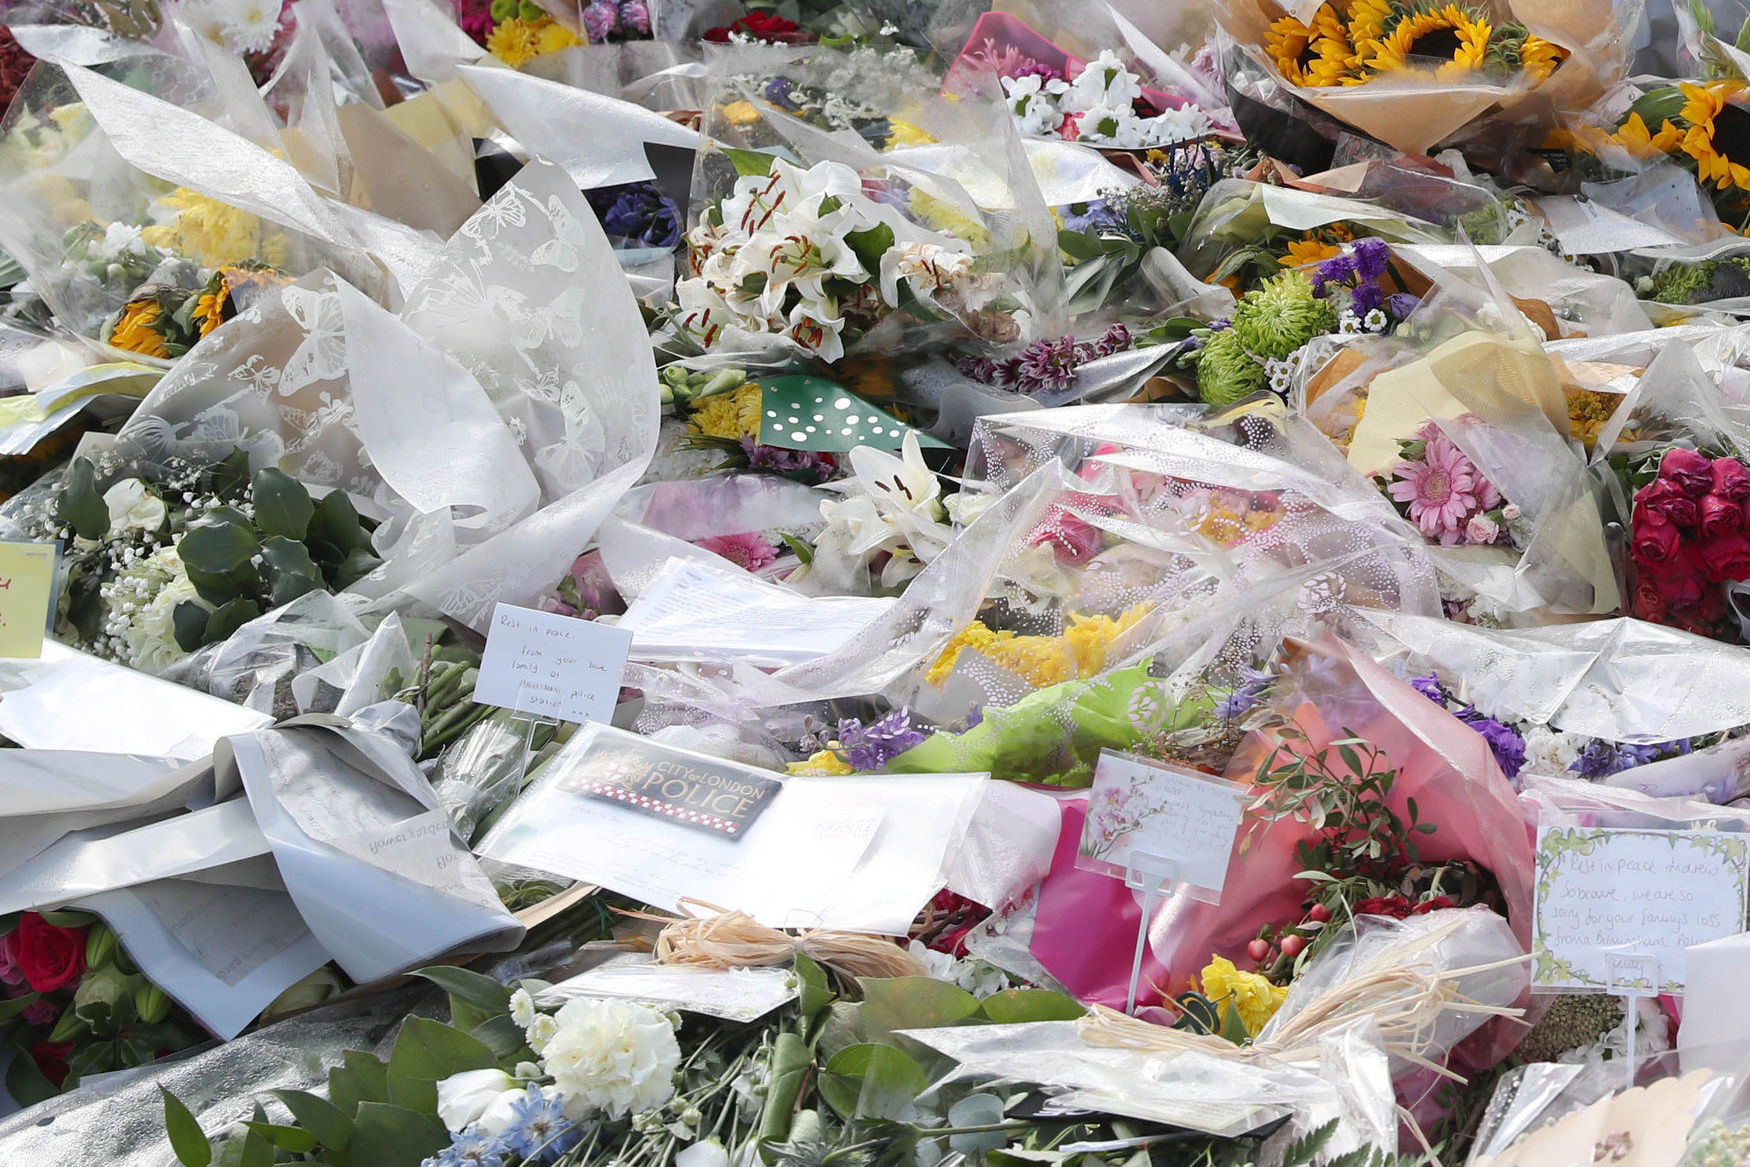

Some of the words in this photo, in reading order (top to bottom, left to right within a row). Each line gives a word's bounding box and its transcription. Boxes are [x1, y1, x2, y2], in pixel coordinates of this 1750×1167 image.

[500, 615, 520, 628] Rest
[512, 660, 538, 674] family
[550, 670, 560, 678] at
[555, 657, 579, 666] your
[589, 661, 607, 672] blue
[529, 696, 562, 706] station
[570, 690, 597, 701] police
[641, 771, 755, 818] POLICE
[701, 774, 765, 800] LONDON
[1570, 857, 1596, 874] Rest
[1600, 860, 1614, 871] in
[1617, 859, 1657, 879] peace
[1666, 857, 1719, 875] Andrew
[1560, 881, 1576, 898] So
[1632, 891, 1650, 901] we
[1654, 891, 1675, 901] are
[1679, 891, 1695, 902] so
[1552, 906, 1581, 929] sorry
[1585, 908, 1604, 926] for
[1606, 914, 1635, 930] your
[1640, 908, 1688, 934] family's
[1697, 912, 1721, 928] loss
[1597, 929, 1667, 952] Birmingham
